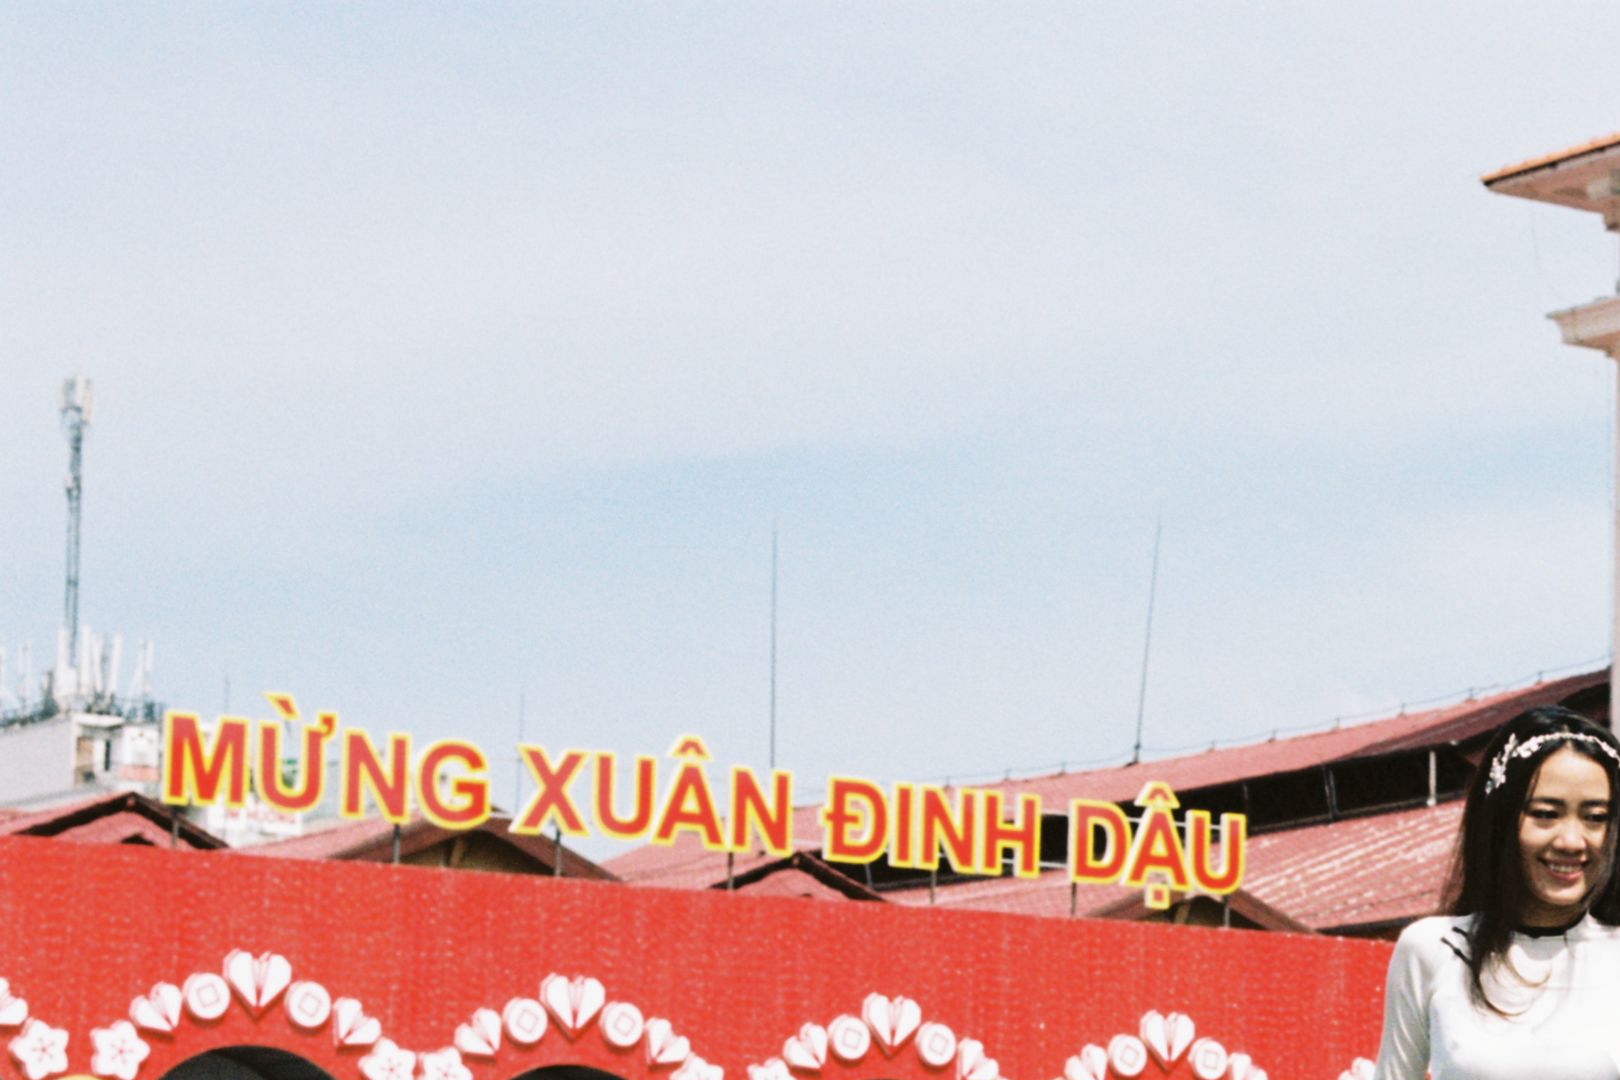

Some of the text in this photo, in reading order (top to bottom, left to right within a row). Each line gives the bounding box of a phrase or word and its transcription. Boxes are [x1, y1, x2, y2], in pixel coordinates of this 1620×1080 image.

[164, 692, 1247, 910] MỪNG XUÂN ĐINH DẬU
